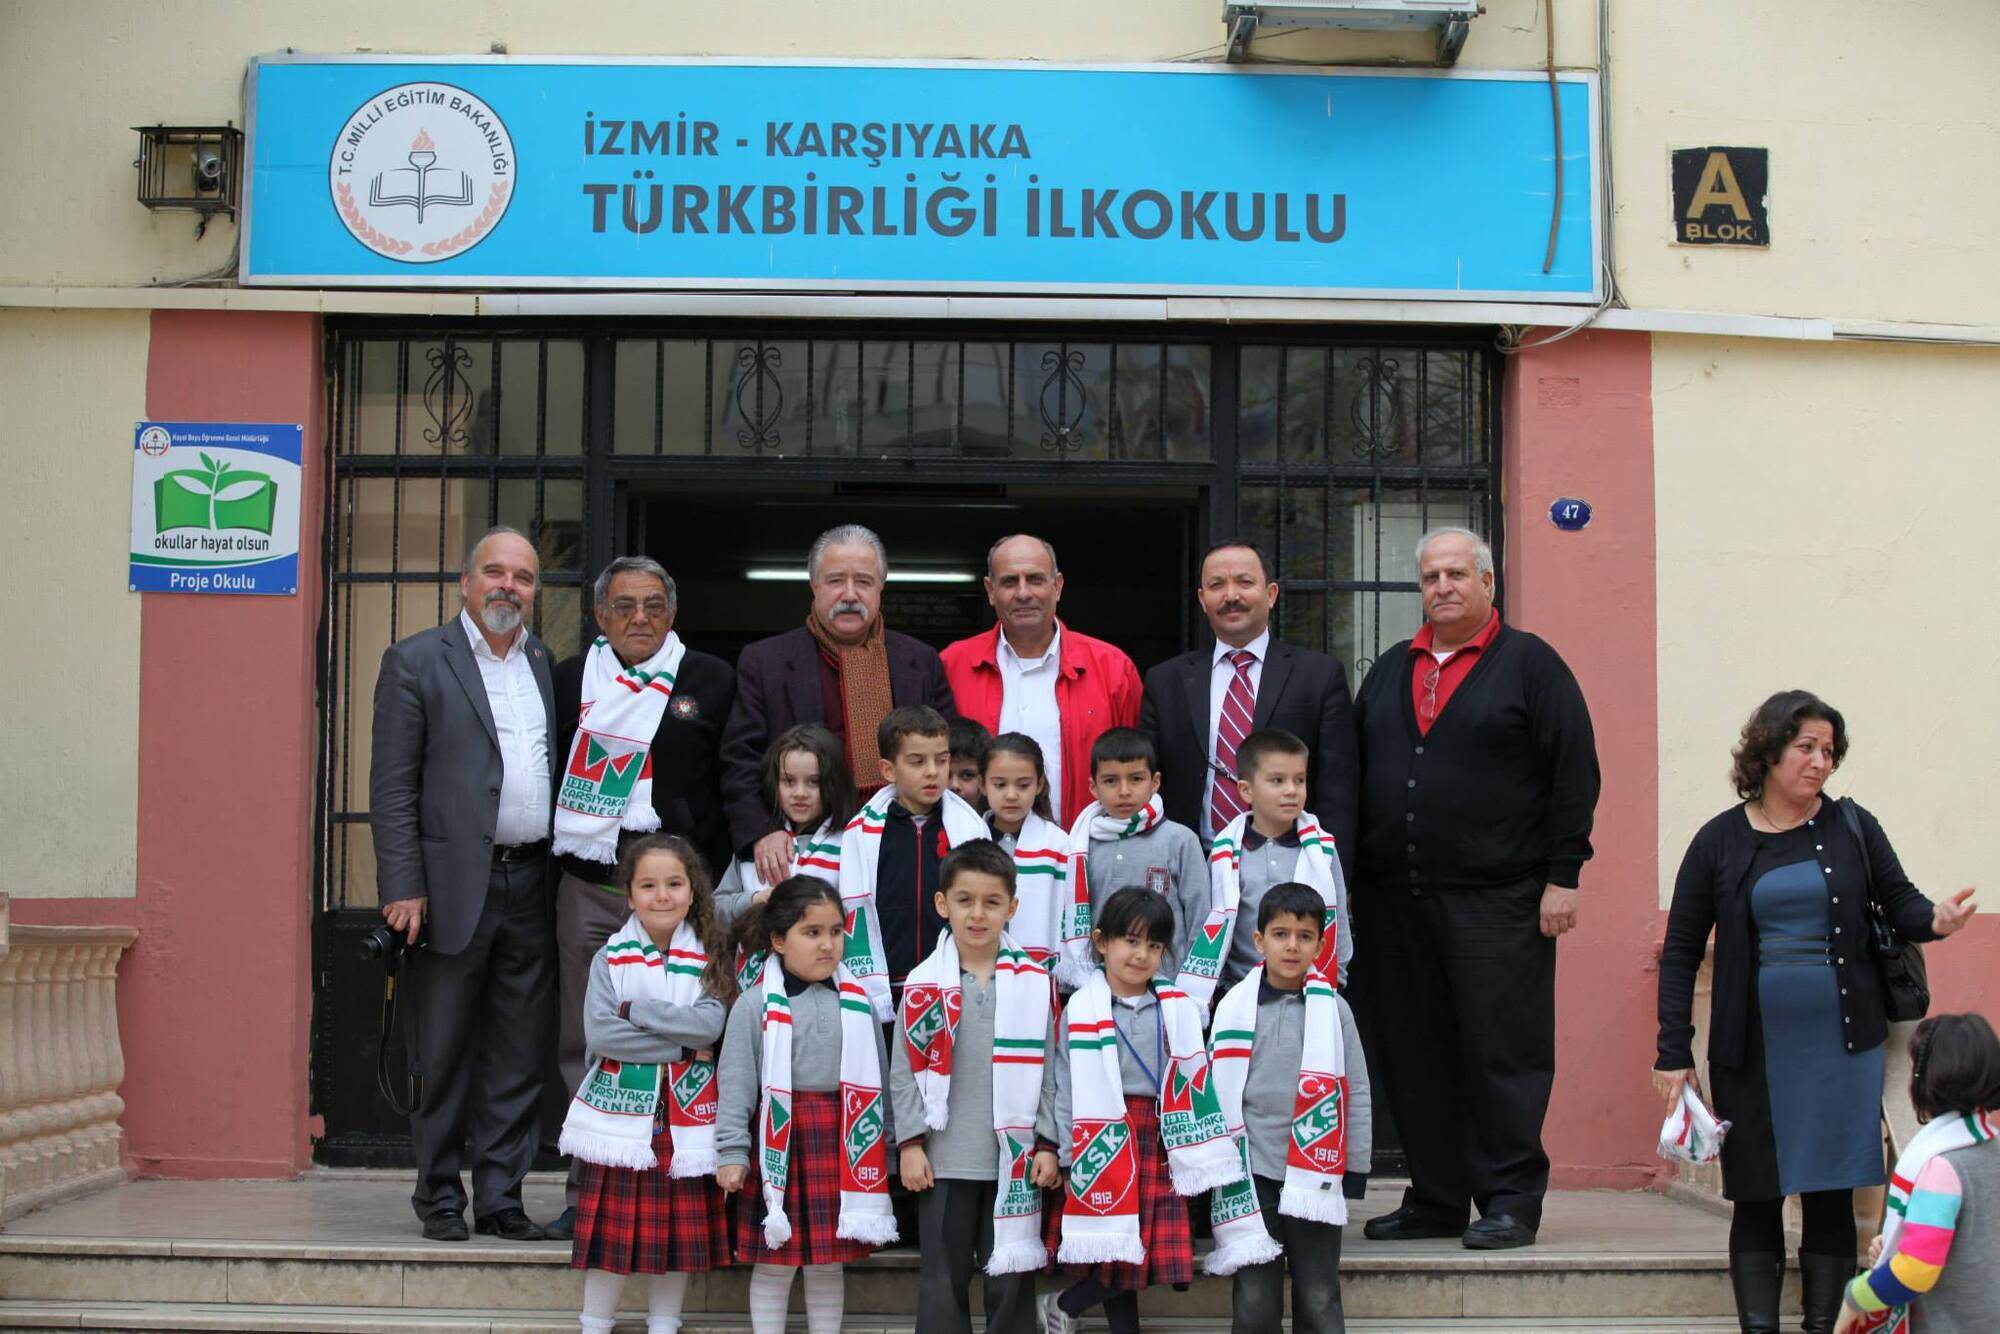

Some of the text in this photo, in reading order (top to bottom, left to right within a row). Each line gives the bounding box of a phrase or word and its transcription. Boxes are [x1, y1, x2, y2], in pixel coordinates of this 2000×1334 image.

[385, 89, 446, 113] EĞİTİM
[449, 96, 510, 176] BAKANLIĞI
[584, 111, 719, 156] İZMİR
[766, 121, 1032, 168] KARŞIYAKA
[1686, 151, 1753, 221] A
[582, 170, 1346, 244] TÜRKBİRLİĞİ İLKOKULU
[1686, 222, 1753, 241] BLOK
[1562, 504, 1579, 519] 47
[154, 534, 269, 553] okullar hayat olsun
[170, 573, 255, 592] Proje Okulu
[1071, 1125, 1127, 1190] K.S.K.
[1314, 1147, 1340, 1163] 1912
[858, 1166, 879, 1181] 1912
[1091, 1191, 1113, 1205] 1912
